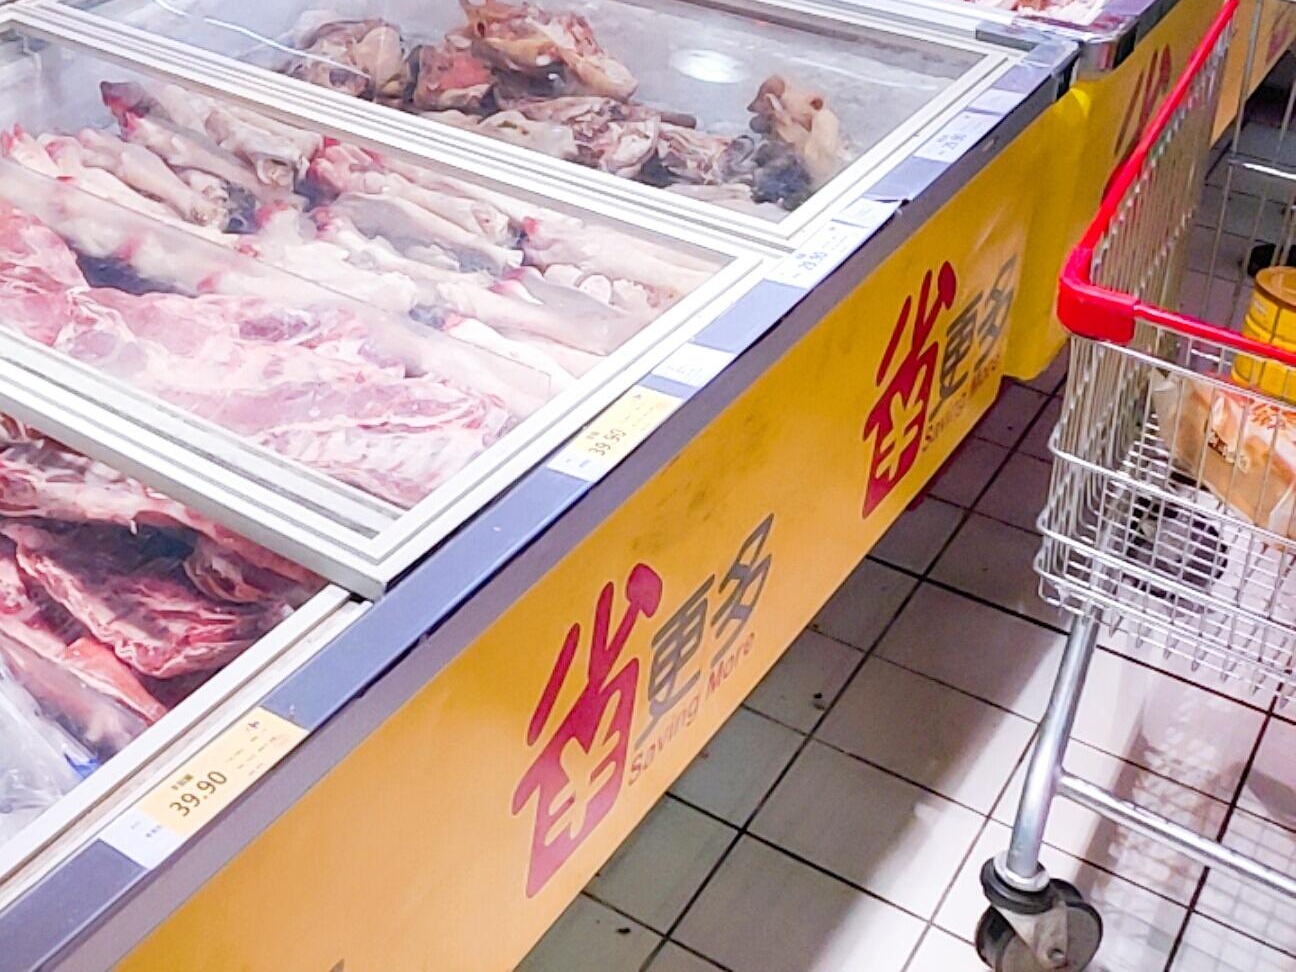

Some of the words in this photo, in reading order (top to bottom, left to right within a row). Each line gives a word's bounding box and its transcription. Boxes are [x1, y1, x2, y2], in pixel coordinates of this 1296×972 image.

[627, 690, 700, 786] Saving
[706, 631, 756, 701] More
[169, 770, 228, 818] 39.90
